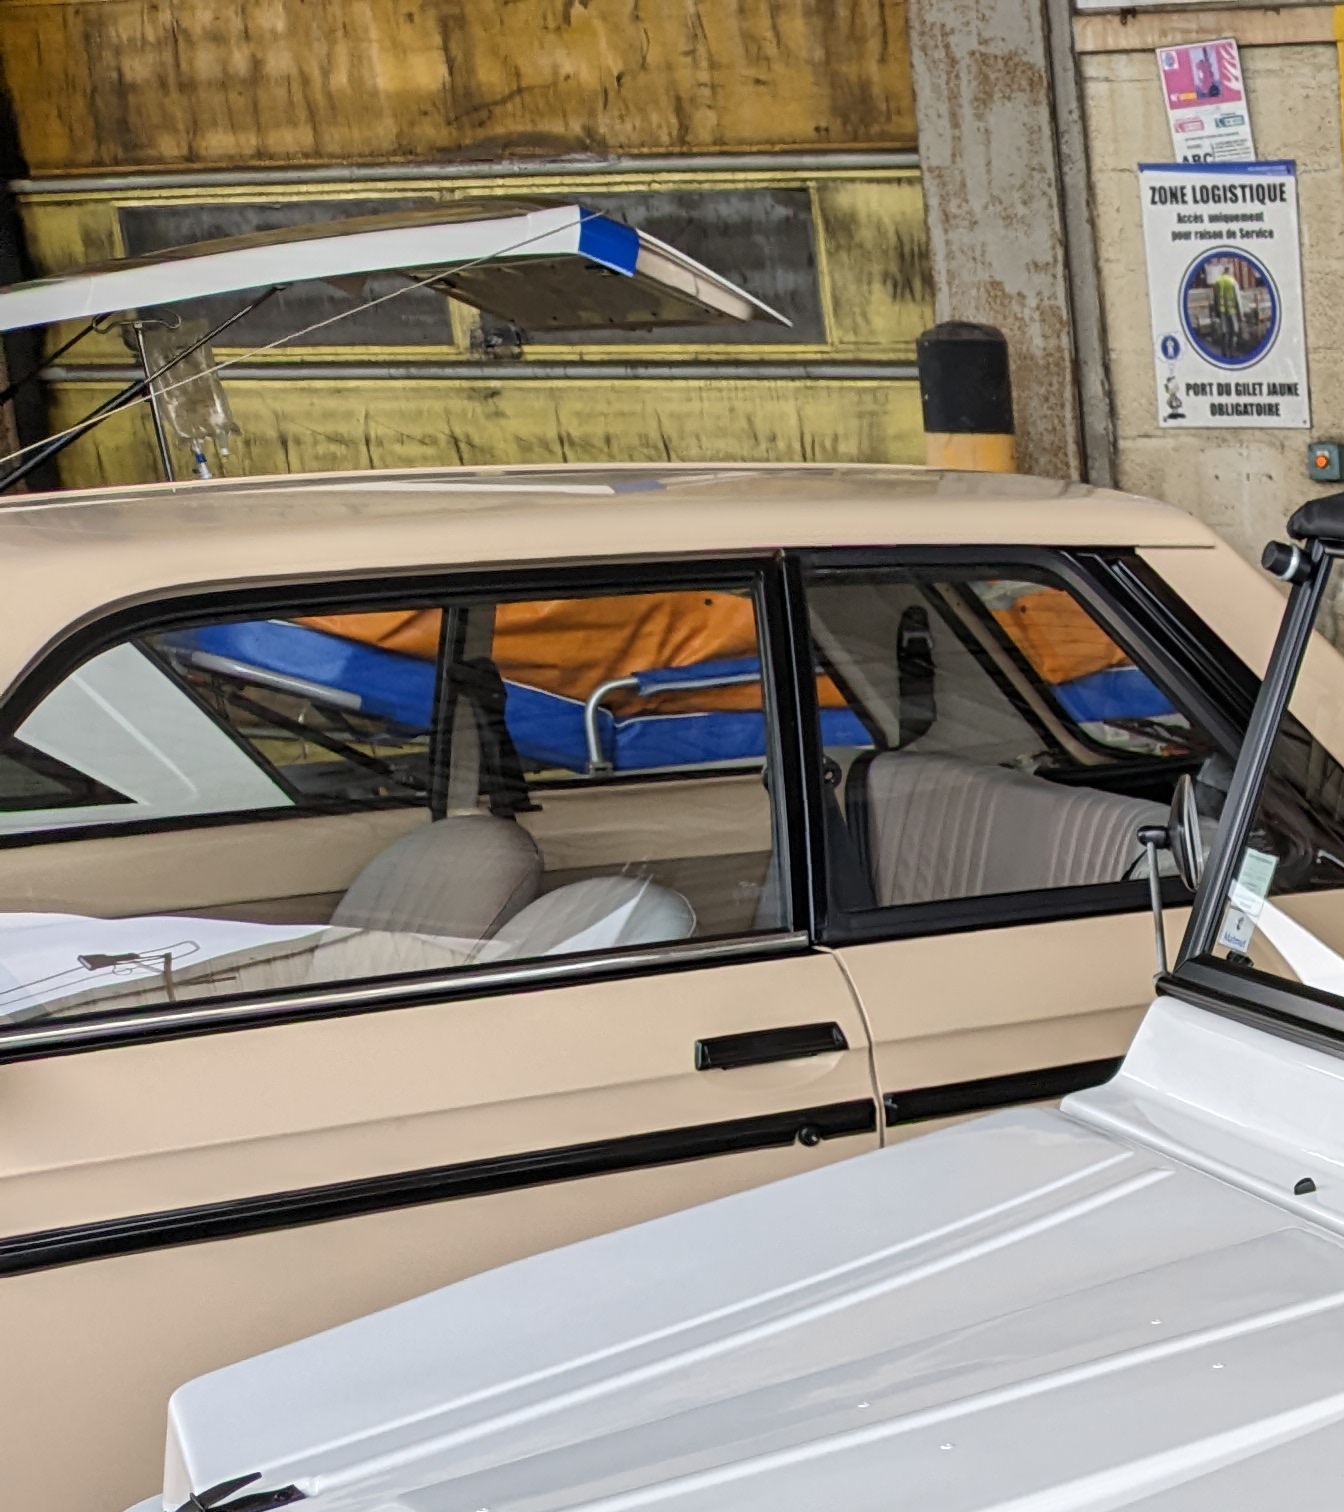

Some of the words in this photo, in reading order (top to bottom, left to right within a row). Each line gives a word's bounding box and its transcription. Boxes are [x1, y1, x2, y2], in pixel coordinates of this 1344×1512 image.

[1150, 185, 1188, 205] ZONE
[1191, 183, 1287, 205] LOGISTIQUE
[1177, 212, 1204, 224] Accès
[1208, 211, 1265, 224] uniquement
[1171, 230, 1192, 242] pour
[1194, 228, 1223, 240] raison
[1226, 228, 1237, 239] de
[1239, 227, 1274, 240] Service
[1185, 382, 1214, 397] PORT
[1216, 382, 1231, 396] DU
[1235, 382, 1264, 397] GILET
[1266, 382, 1300, 397] JAUNE
[1210, 403, 1281, 417] OBLIGATOIRE
